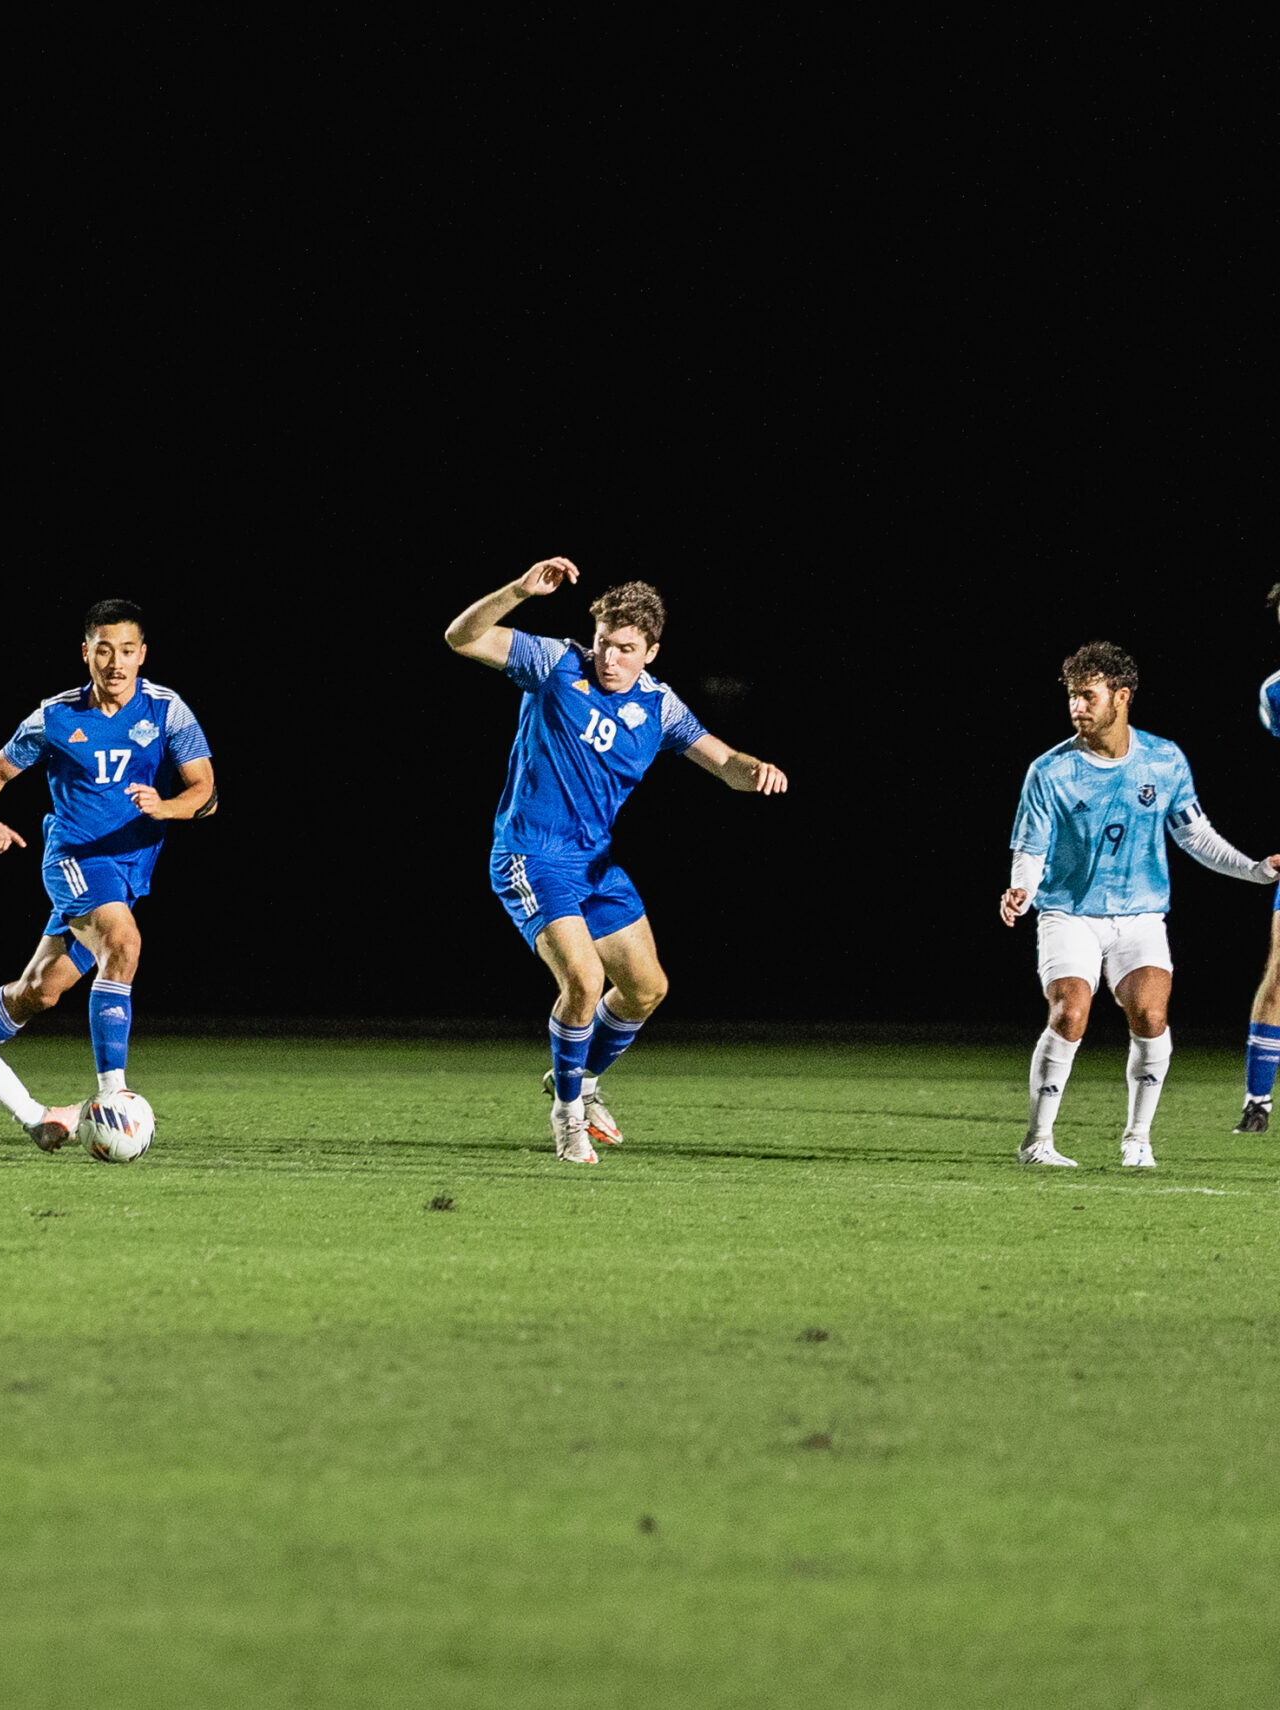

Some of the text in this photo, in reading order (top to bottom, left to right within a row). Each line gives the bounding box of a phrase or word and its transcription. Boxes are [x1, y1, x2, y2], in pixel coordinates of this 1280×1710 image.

[579, 708, 617, 752] 19
[94, 748, 132, 784] 17
[1105, 825, 1125, 856] 9
